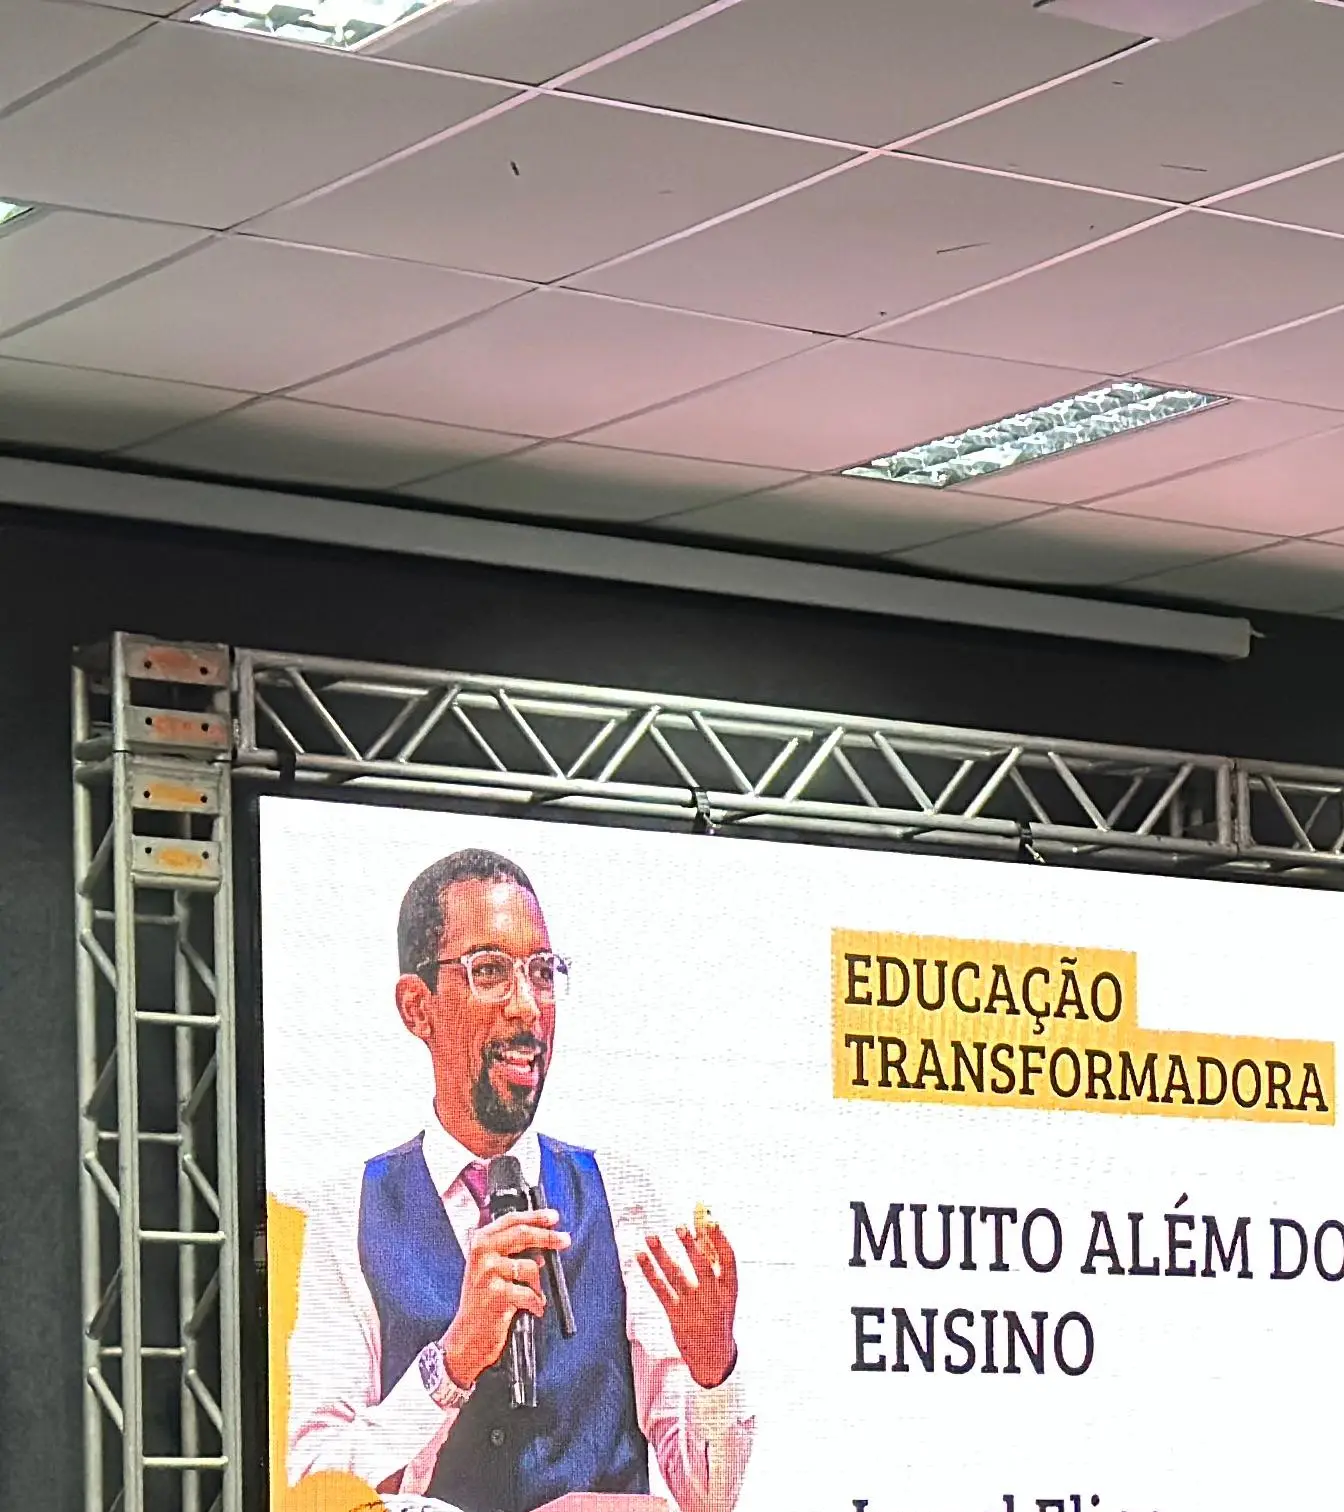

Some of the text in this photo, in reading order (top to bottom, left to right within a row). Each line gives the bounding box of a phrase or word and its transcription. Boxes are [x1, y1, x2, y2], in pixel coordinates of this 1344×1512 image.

[844, 953, 1123, 1033] EDUCAÇÃO
[844, 1033, 1330, 1112] TRANSFORMADORA
[848, 1201, 1063, 1273] MUITO
[1080, 1193, 1254, 1280] ALÉM
[850, 1306, 1095, 1377] ENSINO
